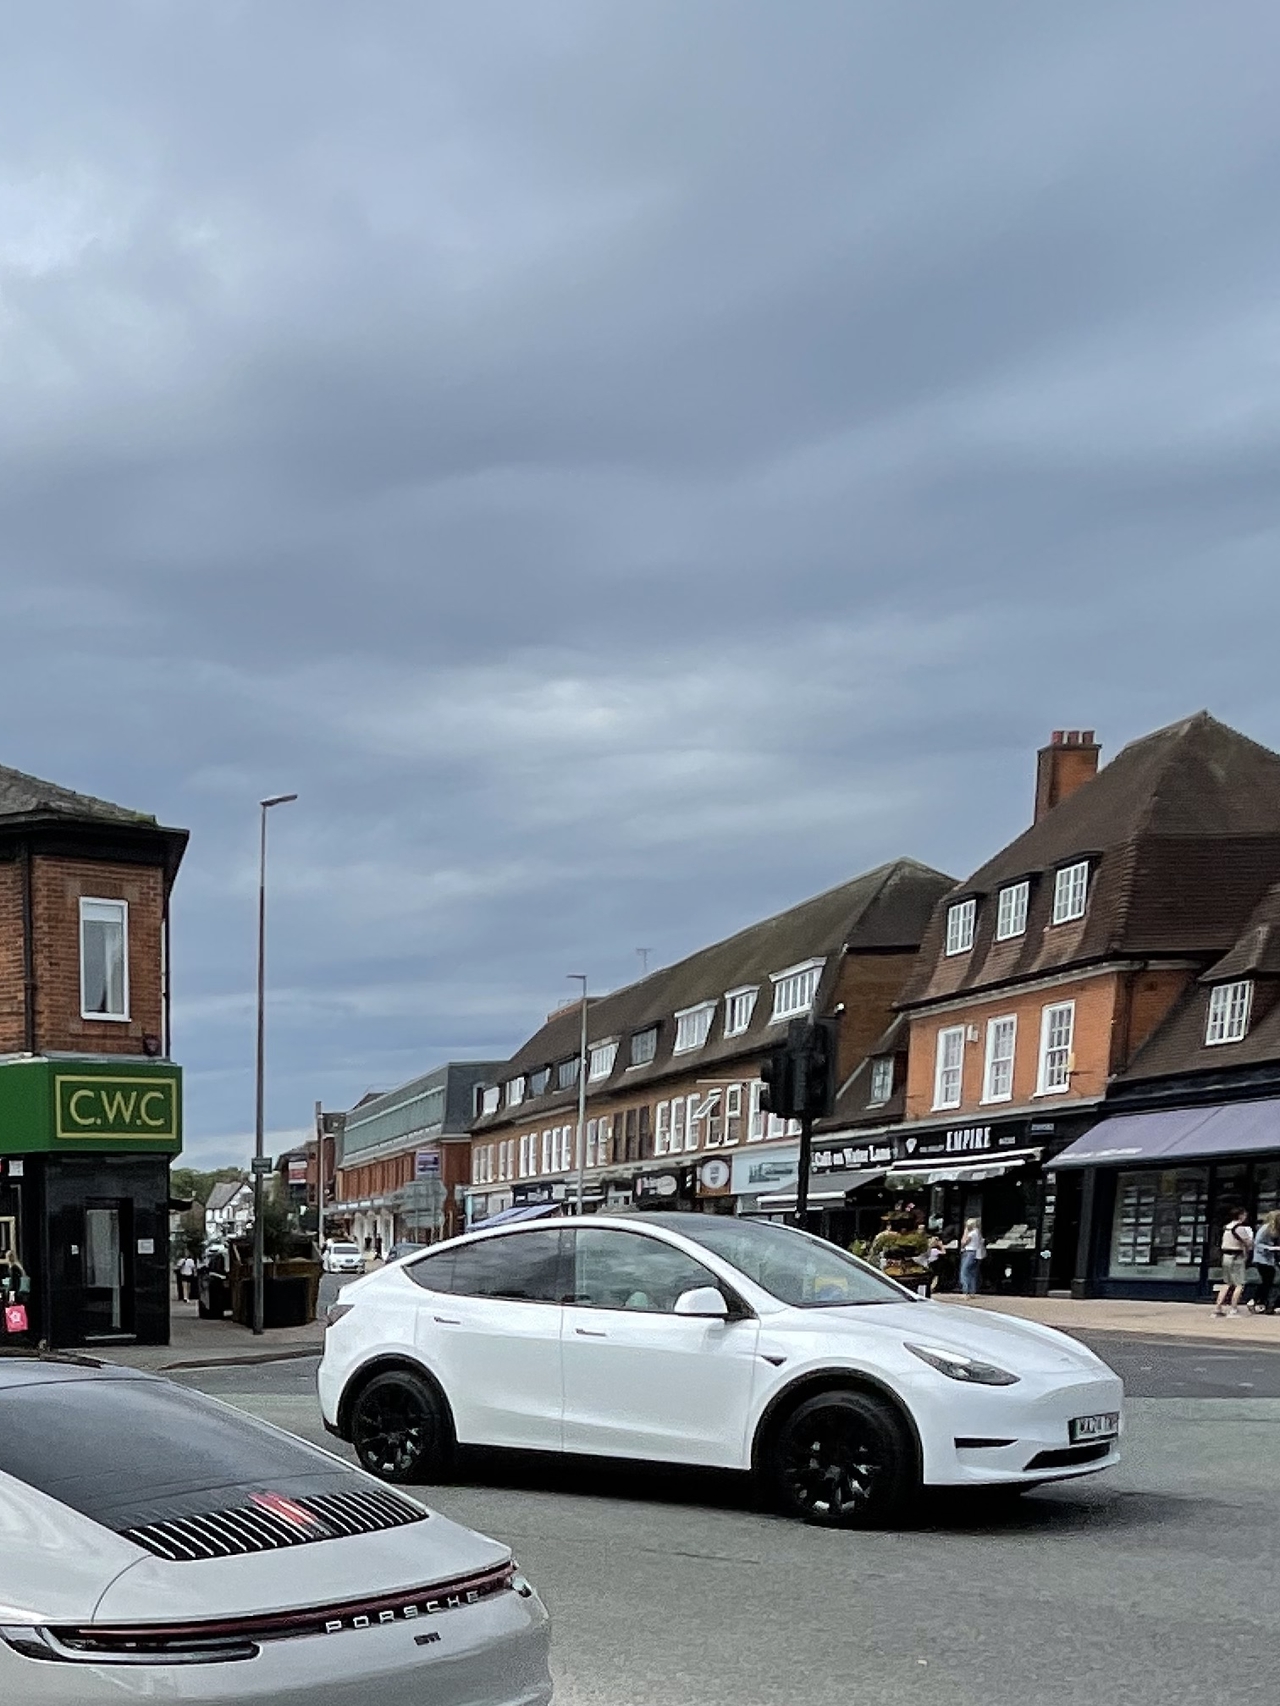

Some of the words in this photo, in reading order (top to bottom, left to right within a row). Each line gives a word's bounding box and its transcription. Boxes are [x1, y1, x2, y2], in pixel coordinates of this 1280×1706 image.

[69, 1089, 165, 1127] C.W.C
[946, 1126, 992, 1153] EMPIRE
[325, 1590, 480, 1634] PORSCHE
